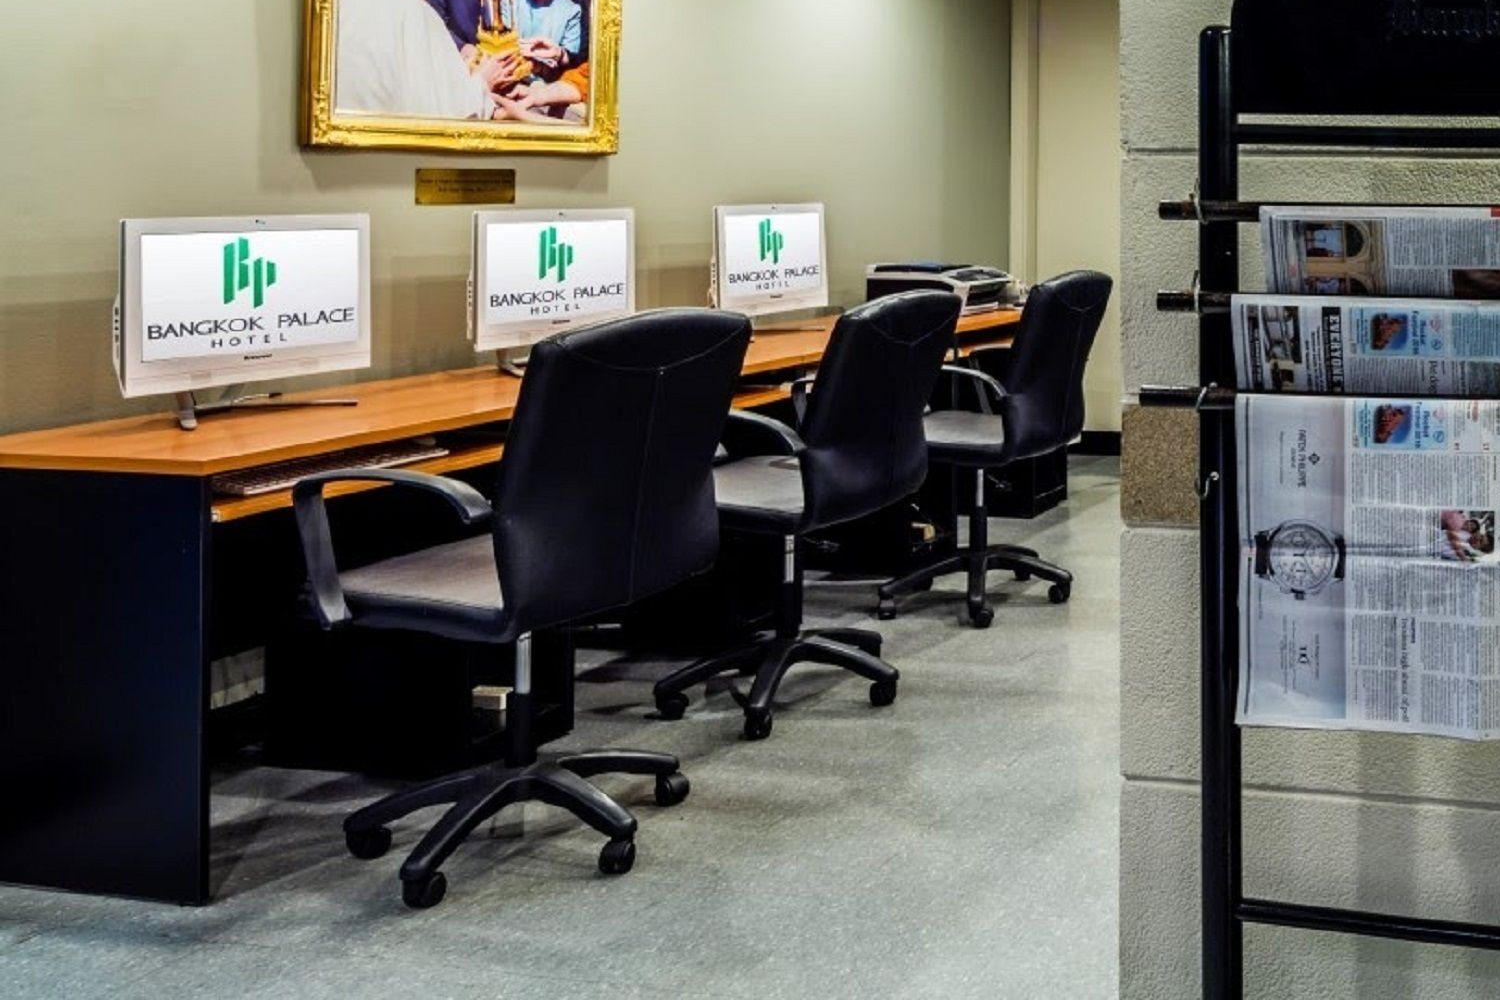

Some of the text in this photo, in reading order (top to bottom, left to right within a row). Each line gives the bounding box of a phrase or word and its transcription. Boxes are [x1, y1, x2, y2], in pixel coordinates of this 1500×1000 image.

[730, 265, 819, 283] BANGKOK PALACE
[490, 283, 624, 308] BANGKOK PALACE
[530, 303, 580, 316] HOTEL
[147, 307, 355, 341] BANGKOK PALACE
[211, 334, 288, 349] HOTEL
